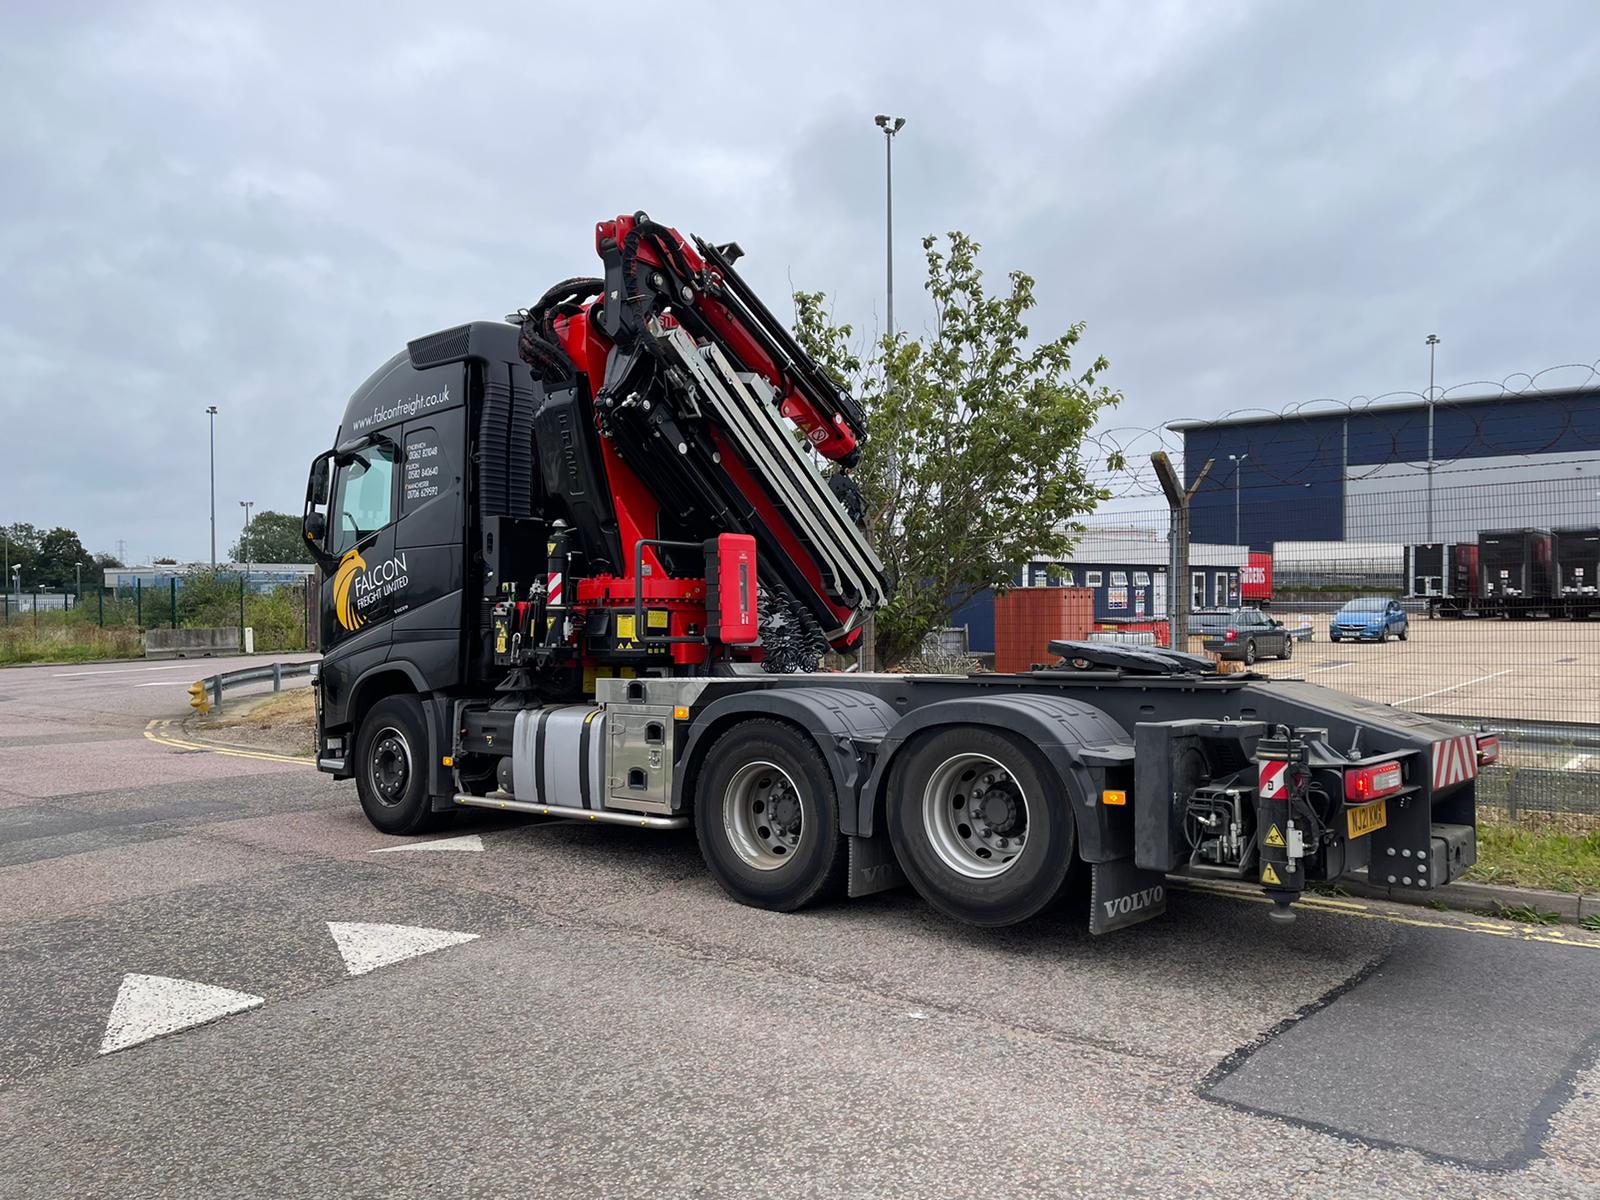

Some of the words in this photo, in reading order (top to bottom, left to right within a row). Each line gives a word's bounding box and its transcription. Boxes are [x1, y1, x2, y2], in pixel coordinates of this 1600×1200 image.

[353, 384, 449, 431] www.falconfreight.co.uk
[355, 552, 408, 598] FALCON
[357, 587, 382, 610] FREIGHT
[383, 575, 409, 596] LIMITED
[1103, 885, 1164, 919] VOLVO
